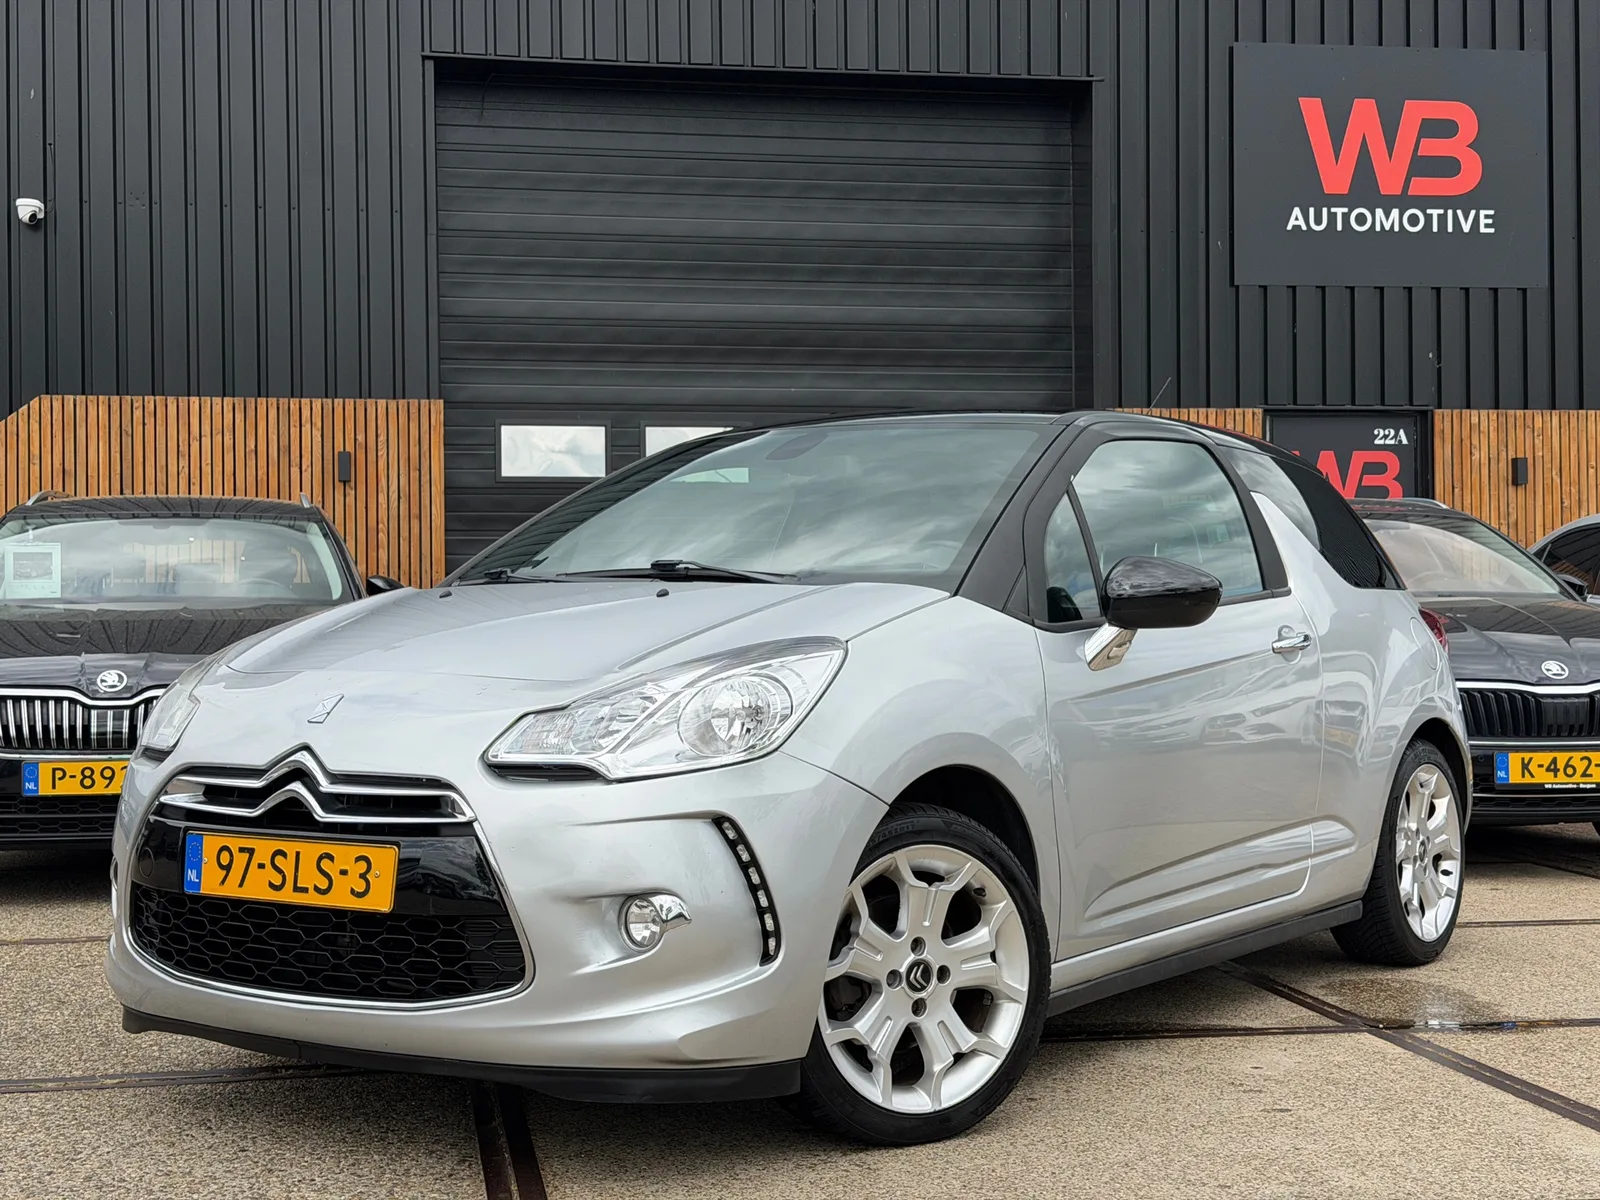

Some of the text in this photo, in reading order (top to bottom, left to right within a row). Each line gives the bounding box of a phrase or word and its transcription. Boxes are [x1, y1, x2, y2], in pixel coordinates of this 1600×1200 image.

[1298, 97, 1483, 196] WB
[1286, 206, 1495, 233] AUTOMOTIVE
[1374, 428, 1409, 445] 22A
[1497, 770, 1508, 778] NL
[25, 782, 37, 790] NL
[187, 869, 199, 882] NL
[216, 844, 373, 899] 97-SLS-3
